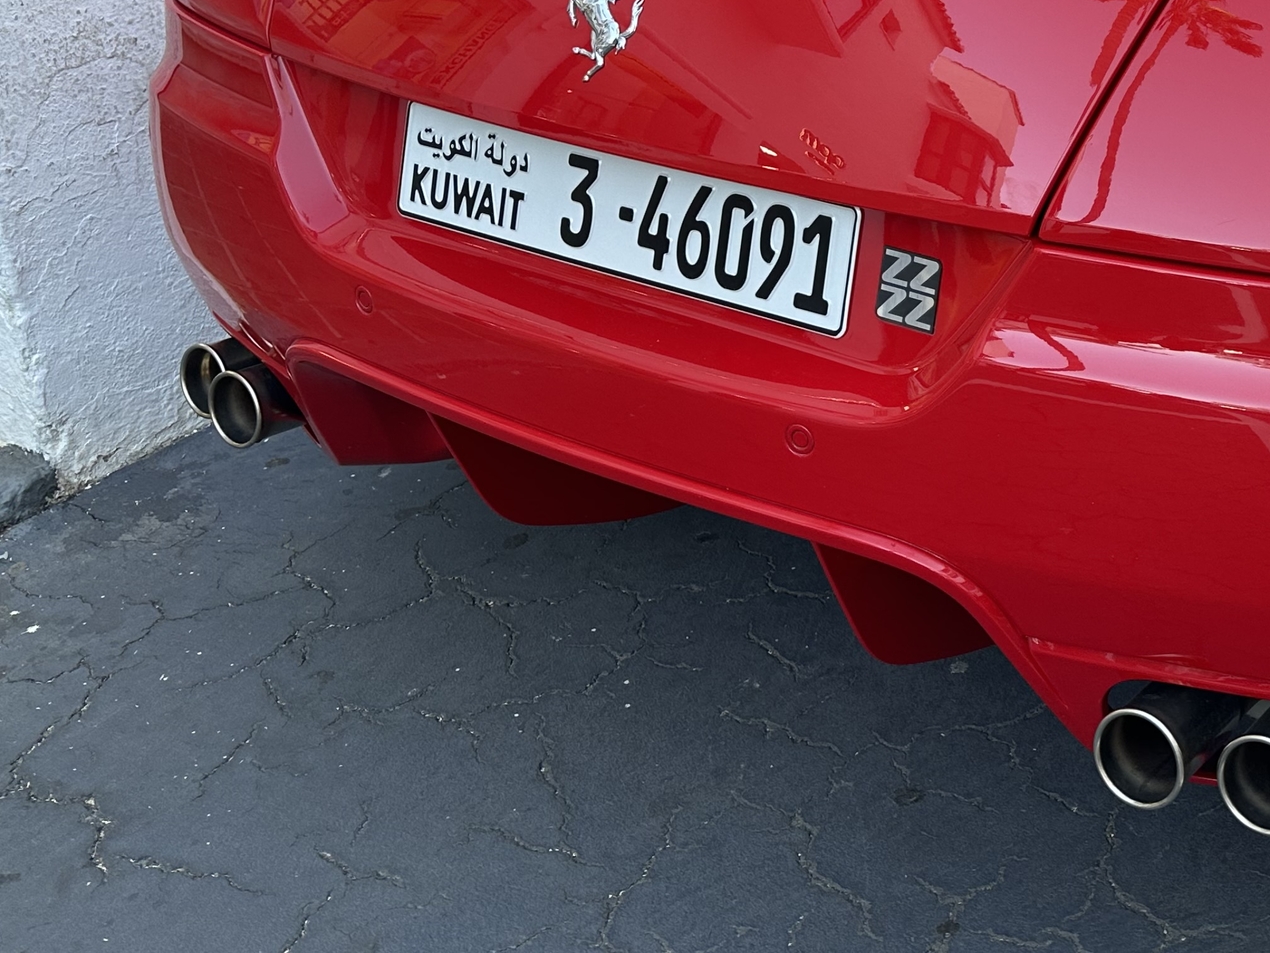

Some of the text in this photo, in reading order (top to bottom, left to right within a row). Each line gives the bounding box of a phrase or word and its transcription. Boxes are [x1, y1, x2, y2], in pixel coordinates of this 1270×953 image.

[417, 127, 529, 178] دولة الكويت
[409, 163, 526, 232] KUWAIT
